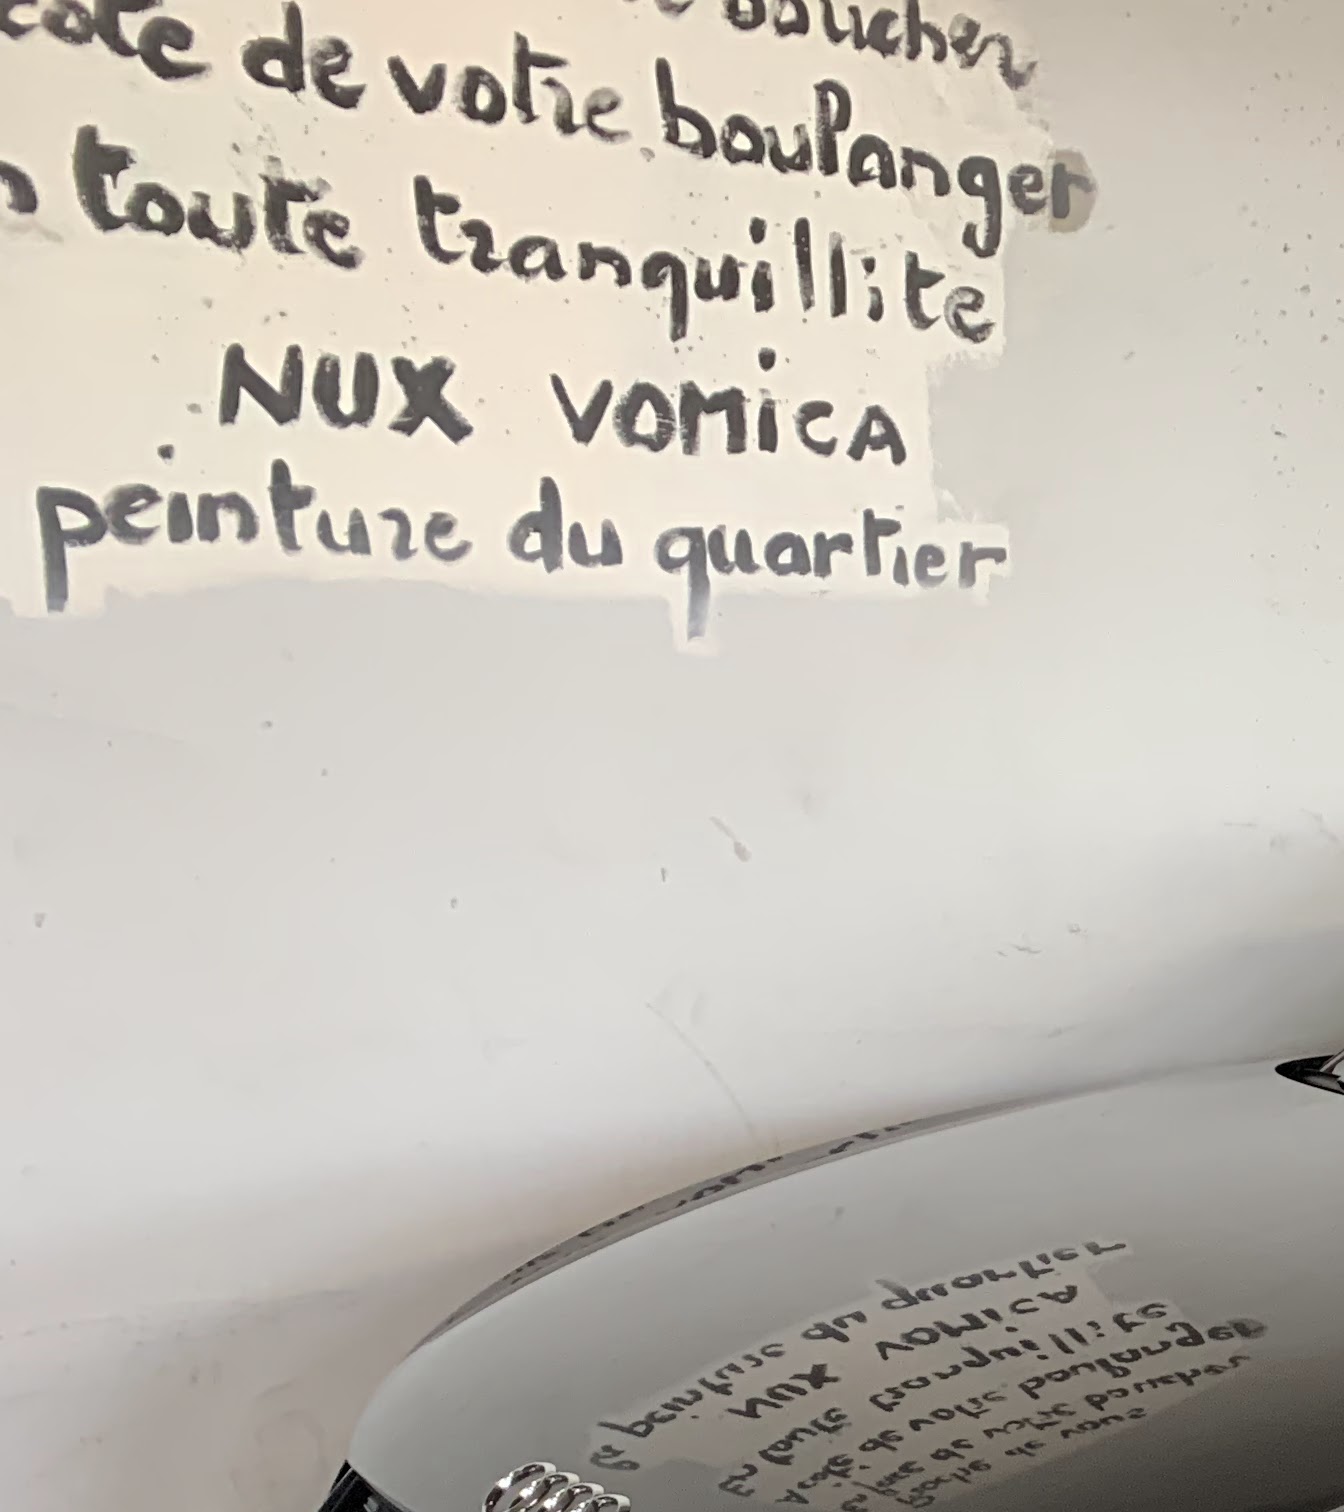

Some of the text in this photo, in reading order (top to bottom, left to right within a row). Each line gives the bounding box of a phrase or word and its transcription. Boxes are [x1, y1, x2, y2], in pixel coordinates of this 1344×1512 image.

[240, 0, 366, 109] de
[72, 125, 363, 270] toute
[218, 343, 474, 444] NUX
[507, 476, 623, 574] du
[655, 508, 1007, 640] quartier
